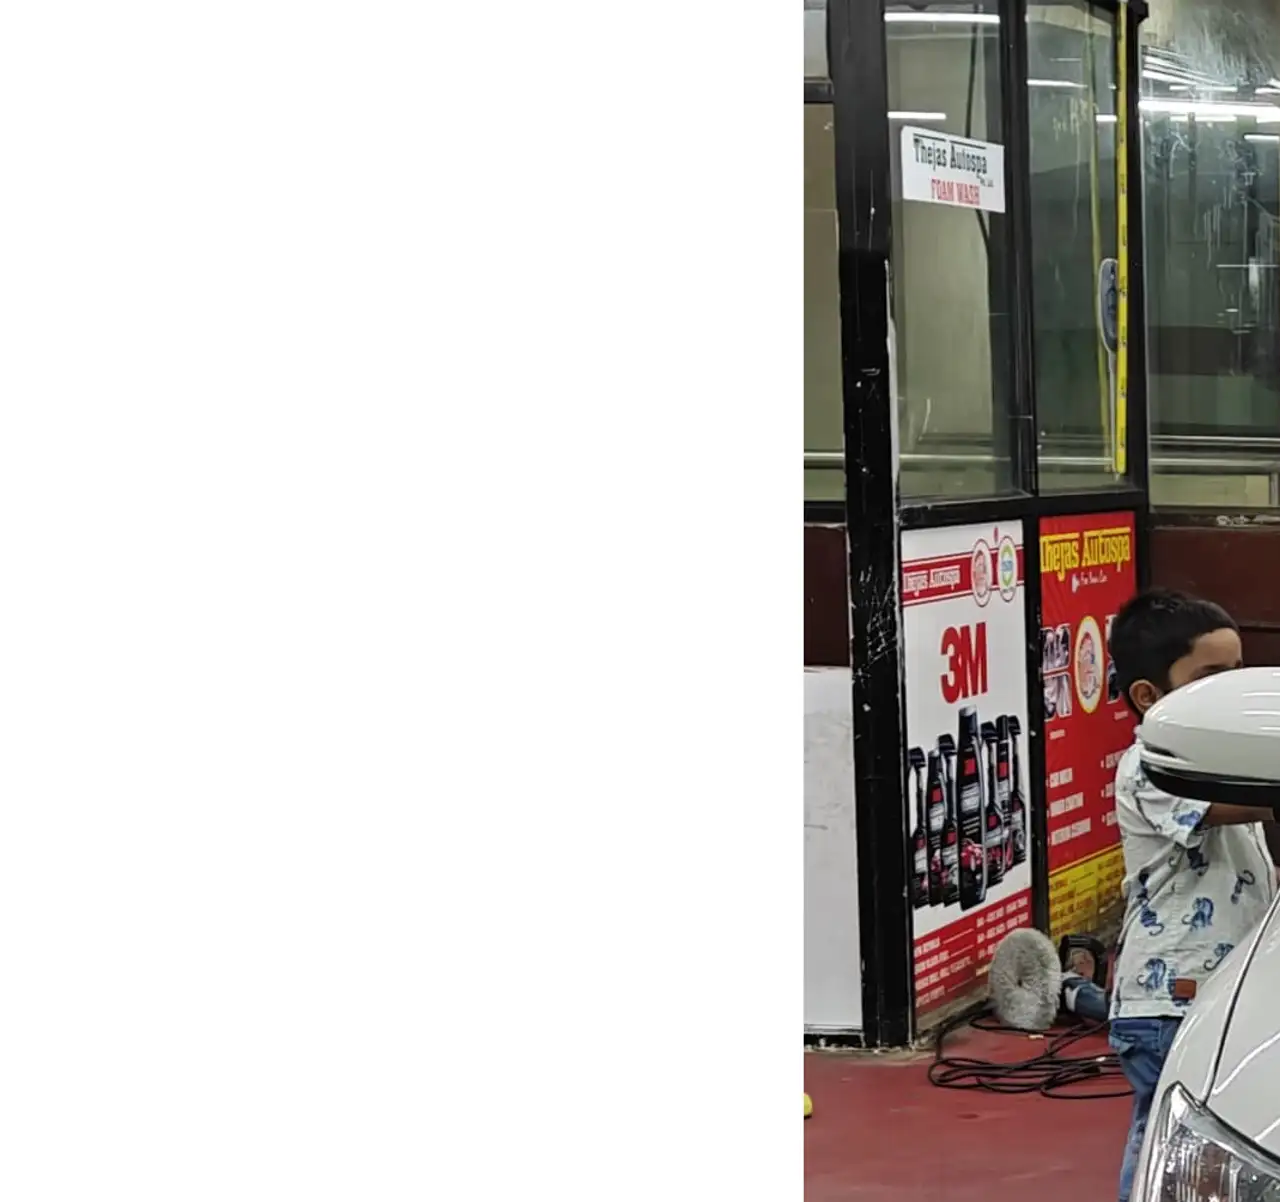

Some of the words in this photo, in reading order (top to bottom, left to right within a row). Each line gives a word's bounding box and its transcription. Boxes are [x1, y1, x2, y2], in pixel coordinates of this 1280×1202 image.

[913, 134, 947, 172] Thejas
[948, 140, 987, 178] Autospa
[1081, 526, 1131, 573] Autospa
[940, 622, 988, 704] 3M
